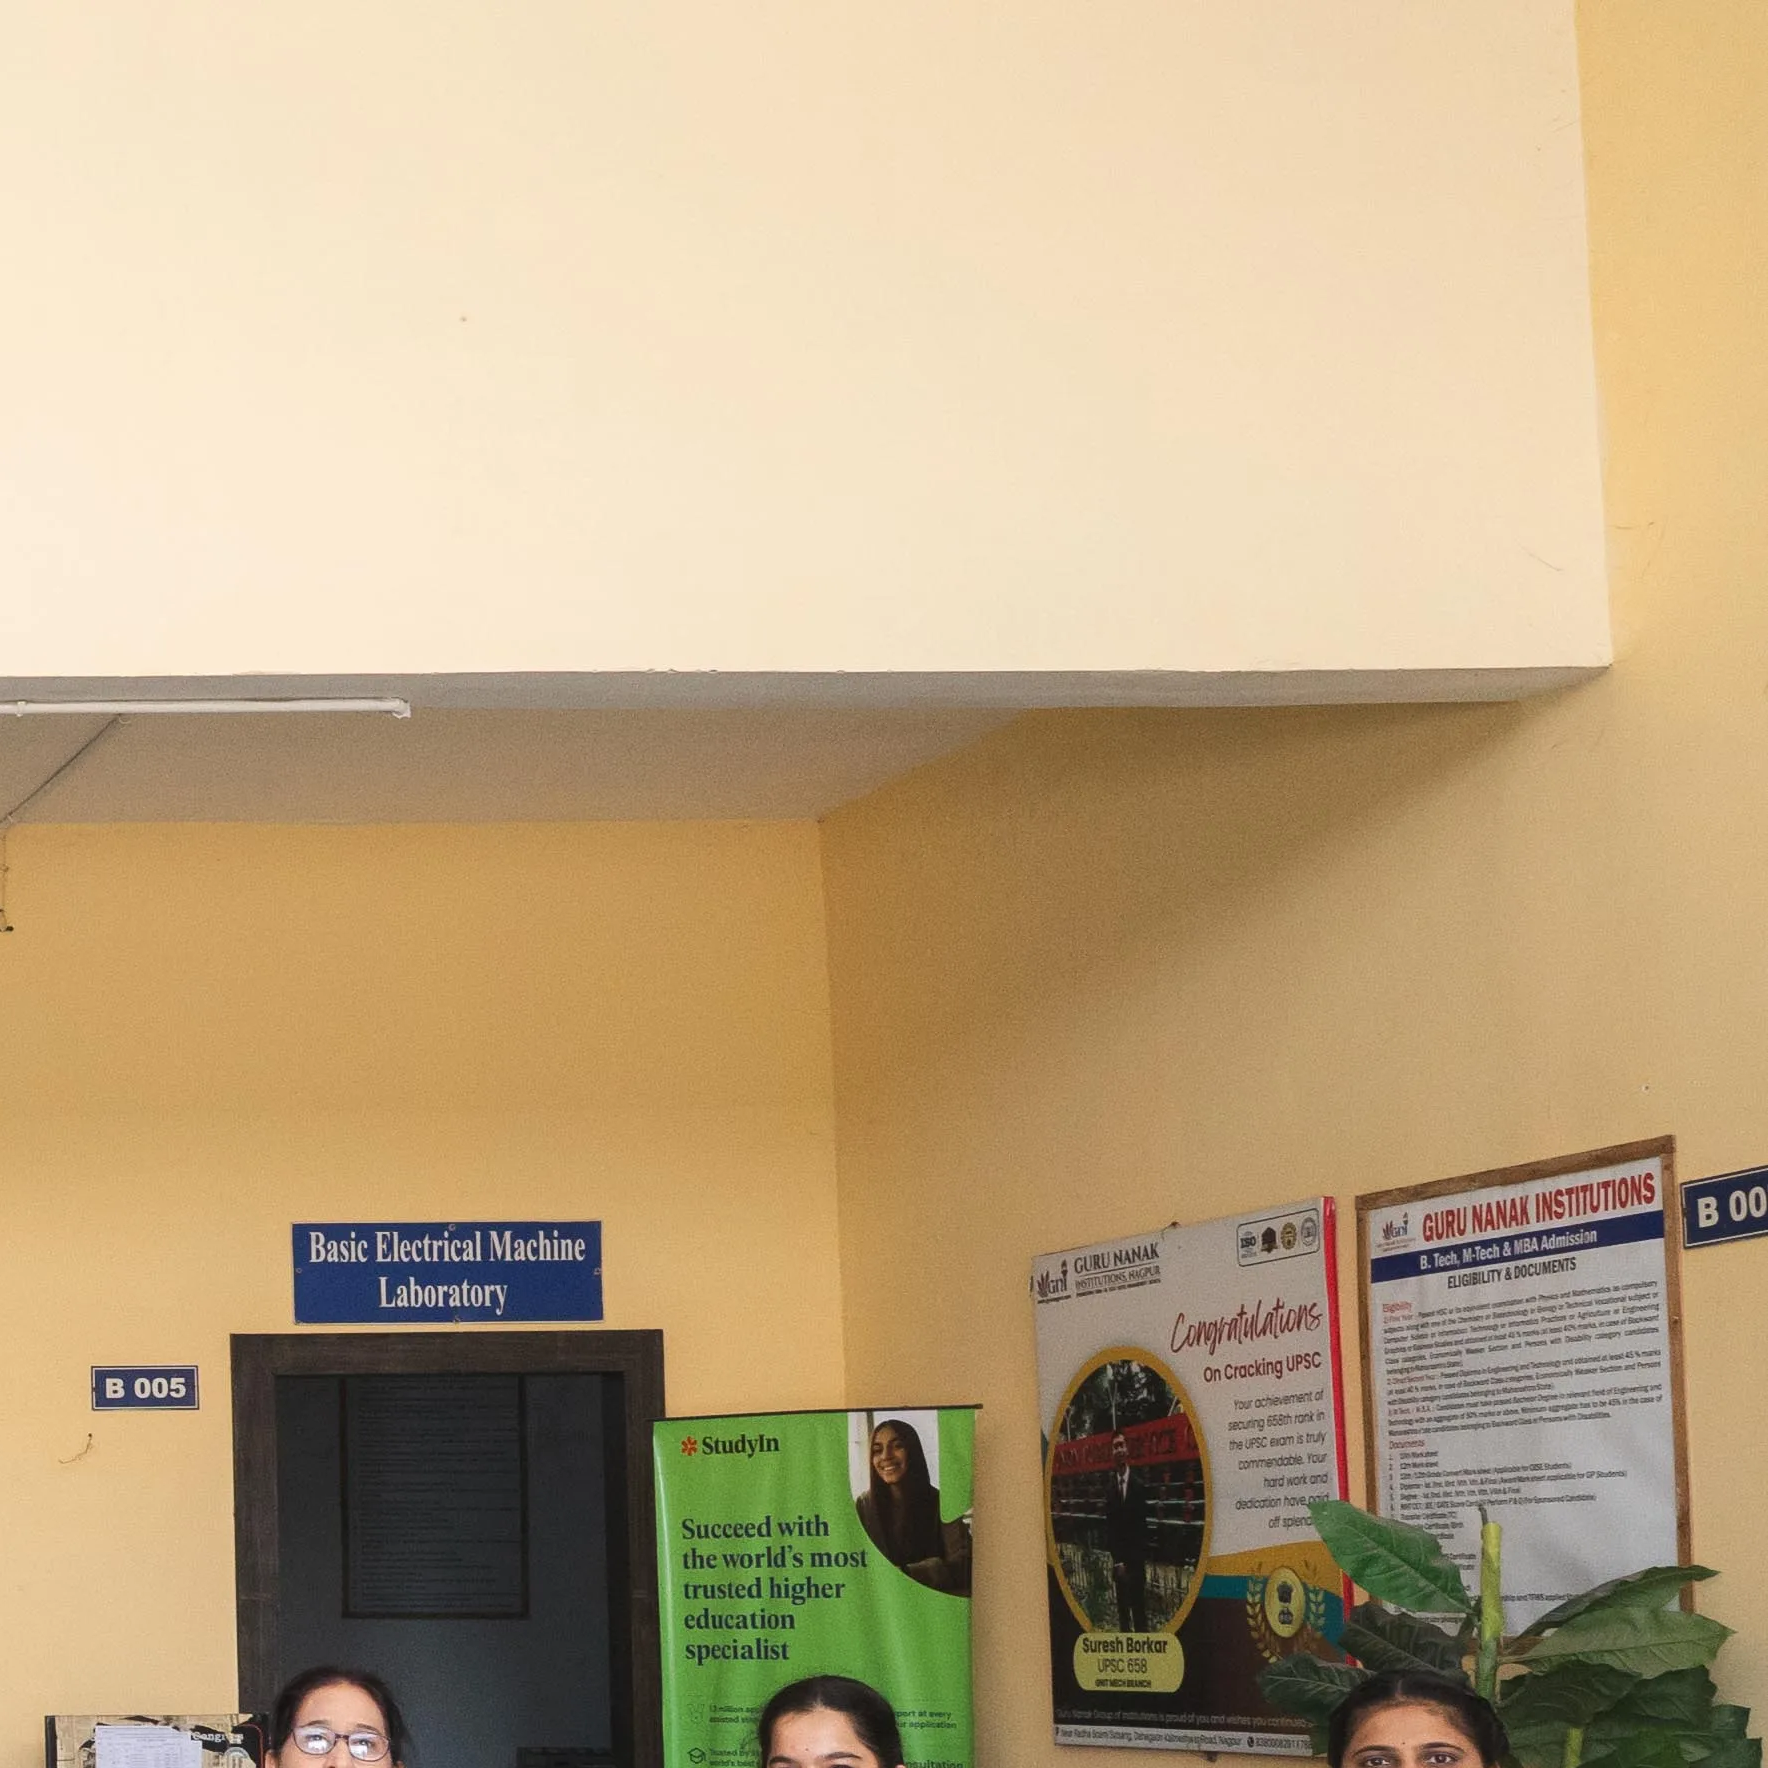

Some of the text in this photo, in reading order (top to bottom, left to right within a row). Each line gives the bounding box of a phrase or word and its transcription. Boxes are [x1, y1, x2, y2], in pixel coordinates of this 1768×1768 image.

[1422, 1172, 1655, 1242] GURU NANAK INSTITUTIONS
[1697, 1185, 1768, 1228] B 00
[309, 1230, 585, 1262] Basic Electrical Machine
[1074, 1242, 1160, 1274] GURU NANAK
[1420, 1228, 1598, 1270] B. Tech, M-Tech & MBA Admission
[1447, 1256, 1577, 1289] ELIGIBILITY & DOCUMENTS
[379, 1276, 508, 1315] Laboratory
[1170, 1298, 1323, 1355] Congratulations
[1203, 1351, 1322, 1382] On Cracking UPSC
[106, 1377, 187, 1399] B 005
[1234, 1389, 1324, 1410] Your achievement of
[1228, 1418, 1265, 1432] securing
[1294, 1411, 1314, 1424] rank
[1316, 1409, 1325, 1421] in
[702, 1433, 780, 1458] StudyIn
[1229, 1440, 1243, 1451] the
[1245, 1436, 1268, 1450] UPSC
[1269, 1434, 1295, 1448] exam
[1306, 1431, 1327, 1446] truly
[1306, 1452, 1328, 1465] Your
[1263, 1472, 1328, 1488] hard work and
[1235, 1494, 1308, 1511] dedication have
[681, 1514, 830, 1539] Succeed with
[1268, 1515, 1280, 1529] off
[682, 1545, 868, 1569] the world’s most
[684, 1576, 846, 1606] trusted higher
[684, 1608, 795, 1630] education
[685, 1637, 790, 1666] specialist
[1082, 1636, 1168, 1655] Suresh Borkar
[1097, 1658, 1148, 1674] UPSC 658
[909, 1720, 957, 1729] application
[929, 1711, 952, 1720] every
